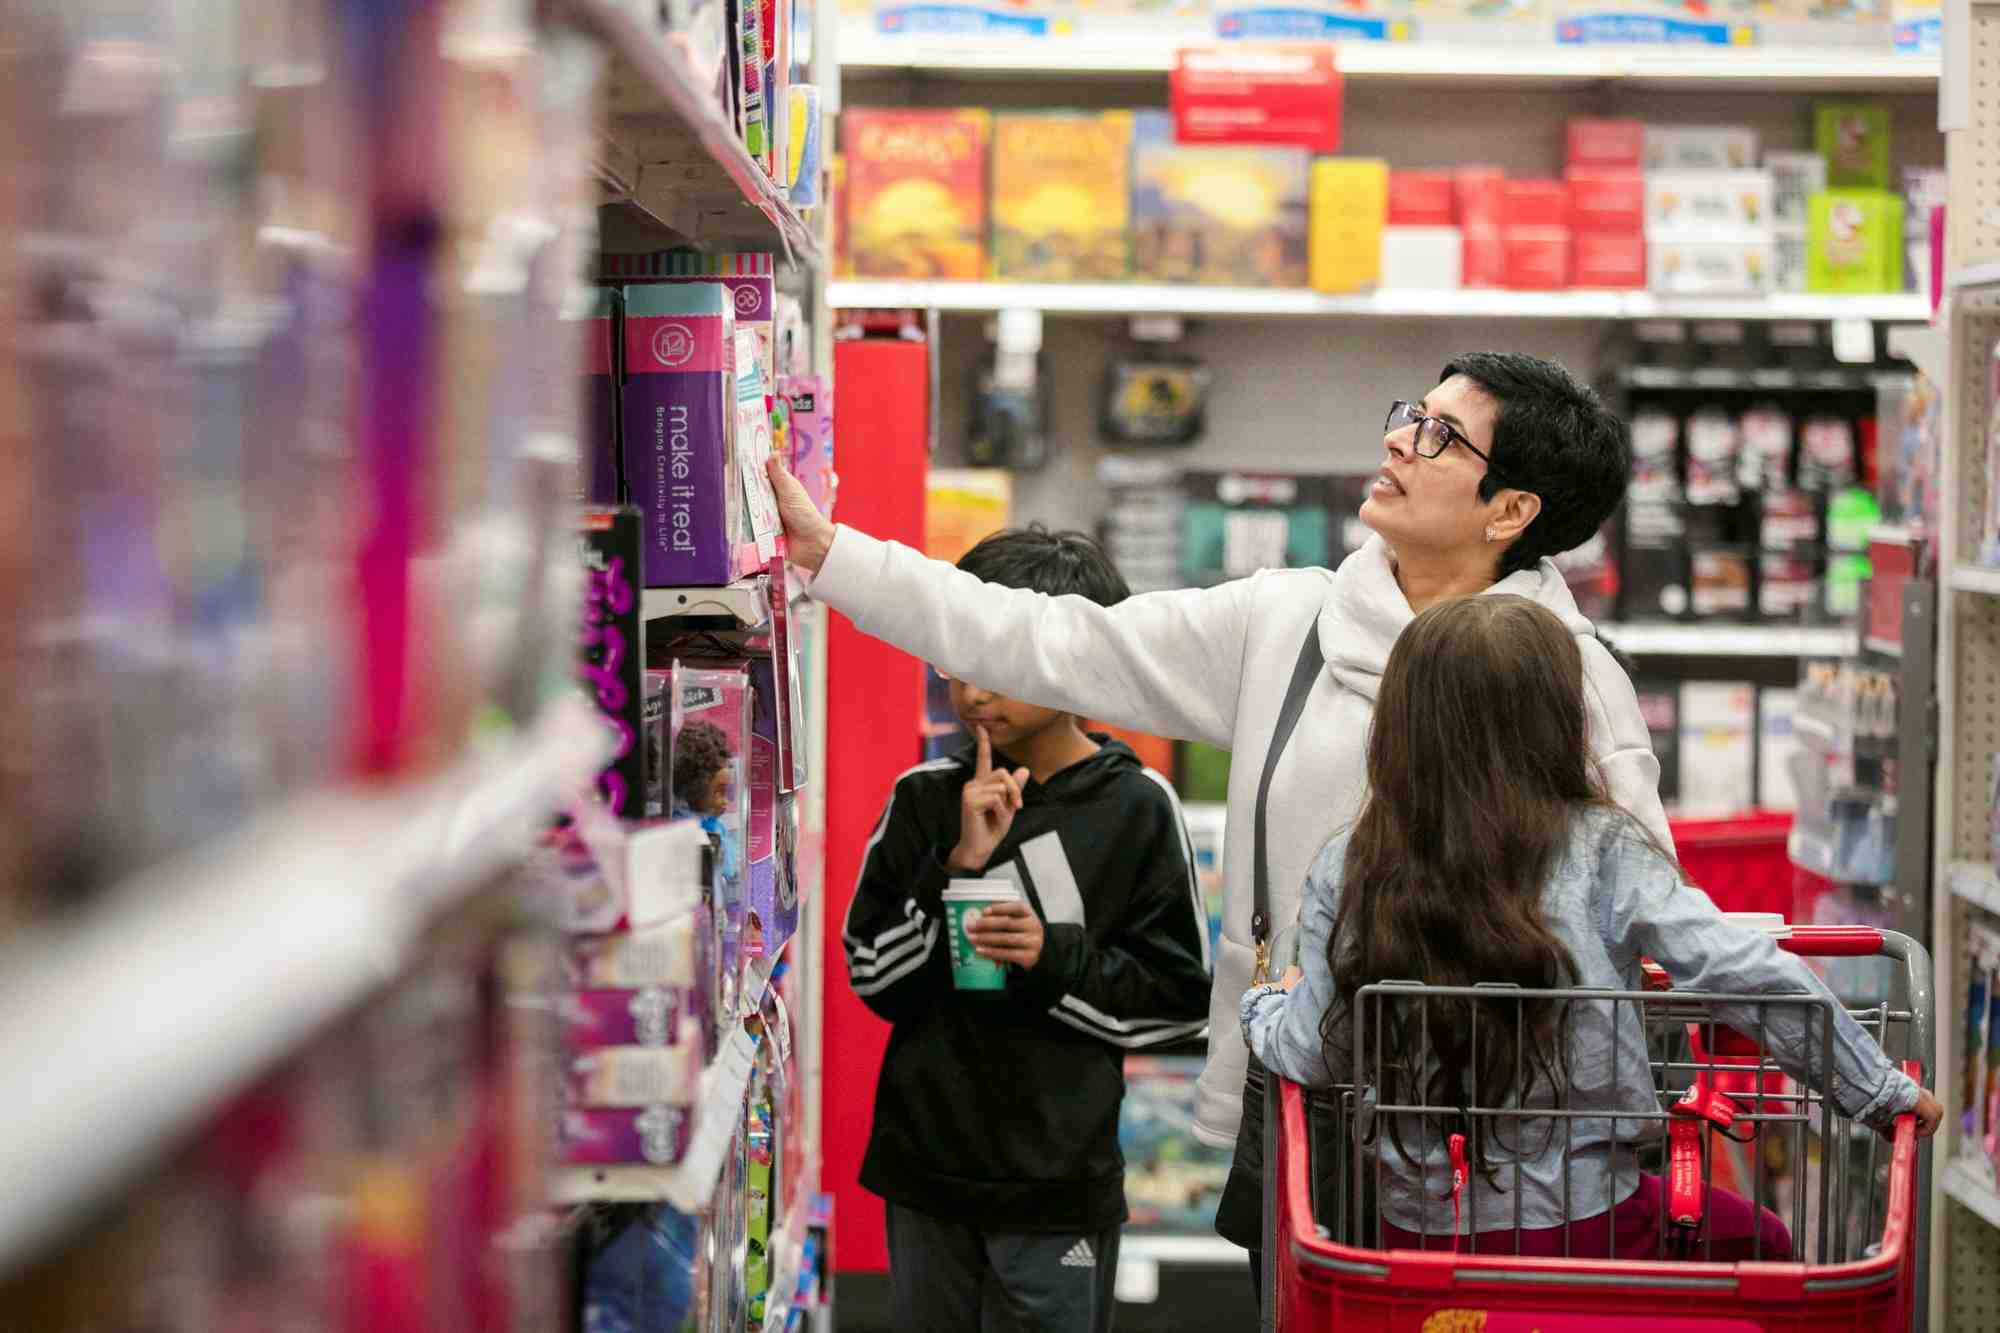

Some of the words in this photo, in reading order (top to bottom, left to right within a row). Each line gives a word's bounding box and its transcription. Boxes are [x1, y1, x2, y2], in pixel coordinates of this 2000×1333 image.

[656, 406, 666, 451] Bringing
[670, 405, 695, 479] make
[656, 455, 667, 508] Creativity
[671, 484, 695, 498] it
